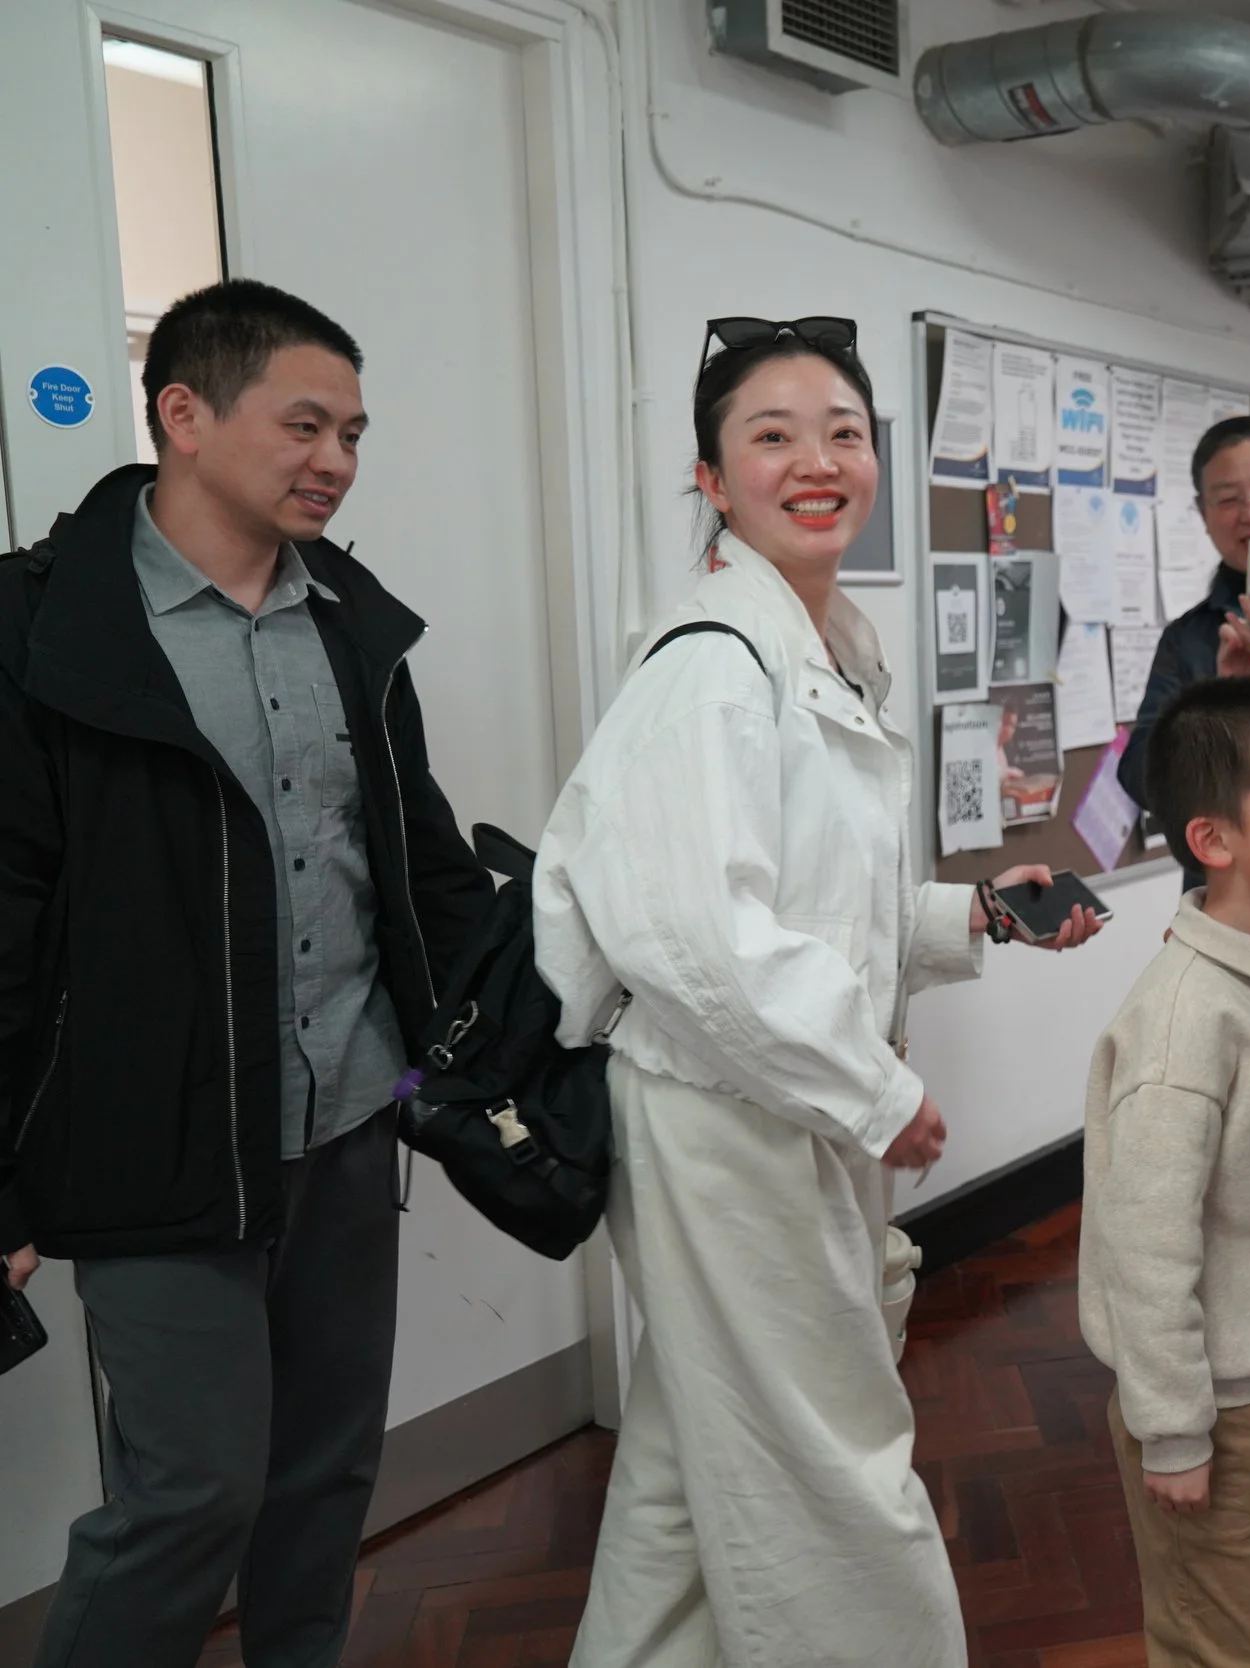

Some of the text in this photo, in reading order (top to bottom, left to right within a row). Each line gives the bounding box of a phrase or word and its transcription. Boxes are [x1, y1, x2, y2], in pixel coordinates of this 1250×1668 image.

[42, 382, 81, 393] Fire Door
[52, 393, 74, 403] Keep
[54, 403, 74, 412] Shut
